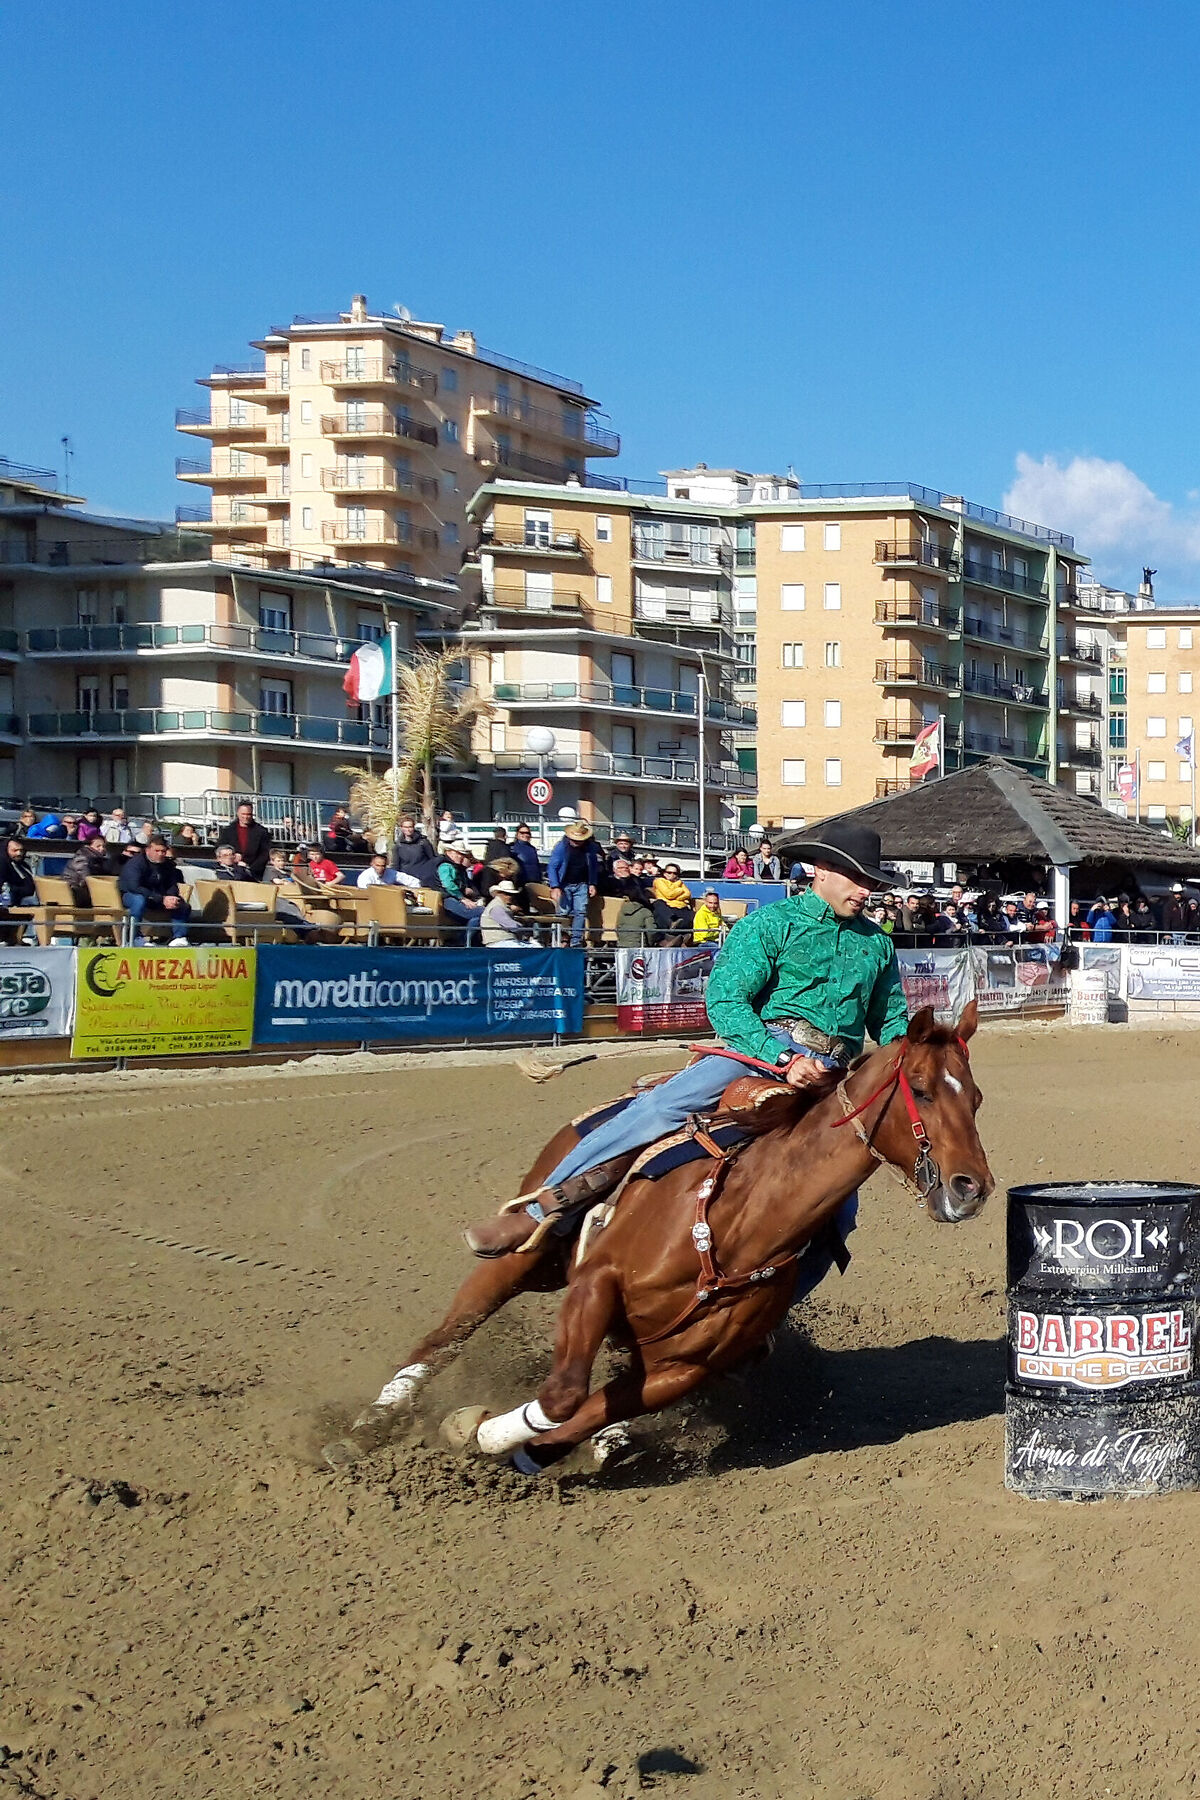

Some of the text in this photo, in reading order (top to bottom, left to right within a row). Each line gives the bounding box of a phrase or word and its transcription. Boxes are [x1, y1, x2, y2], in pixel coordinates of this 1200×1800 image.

[533, 786, 546, 797] 30
[138, 954, 249, 980] MEZALÜNA
[493, 963, 521, 972] STORE
[494, 988, 508, 997] VIA
[1053, 1219, 1146, 1260] ROI
[1040, 1262, 1159, 1277] Extravergini Millesimati
[1018, 1311, 1191, 1356] BARREL
[1026, 1358, 1182, 1378] ON THE BEACH
[1013, 1428, 1187, 1483] Arma di Taggia
